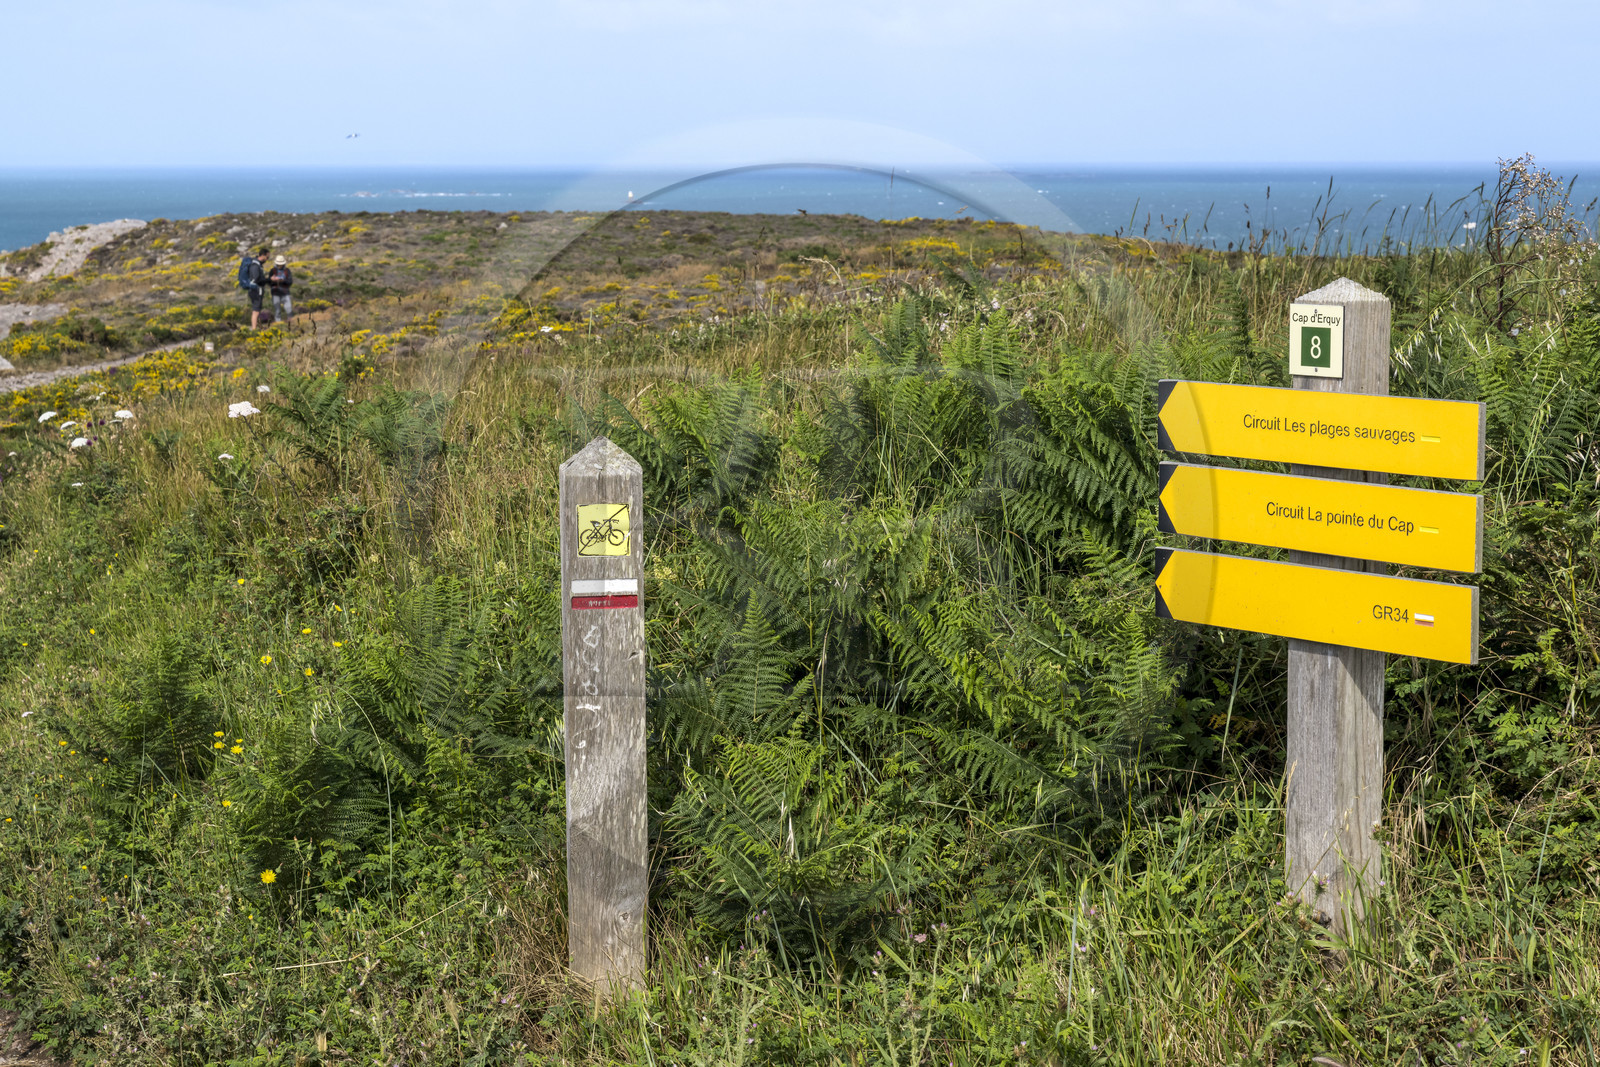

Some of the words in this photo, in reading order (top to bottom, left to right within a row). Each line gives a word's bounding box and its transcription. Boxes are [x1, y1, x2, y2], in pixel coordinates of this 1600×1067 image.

[1292, 313, 1308, 324] Cap
[1310, 313, 1341, 326] d'Erquy
[1310, 335, 1322, 359] 8
[1243, 413, 1281, 431] Circuit
[1284, 417, 1306, 433] Les
[1309, 420, 1351, 439] plages
[1354, 426, 1416, 445] sauvages
[1266, 501, 1304, 520] Circuit
[1307, 506, 1323, 522] La
[1326, 510, 1365, 528] pointe
[1368, 513, 1384, 530] du
[1387, 515, 1415, 536] Cap
[1372, 604, 1410, 624] GR34
